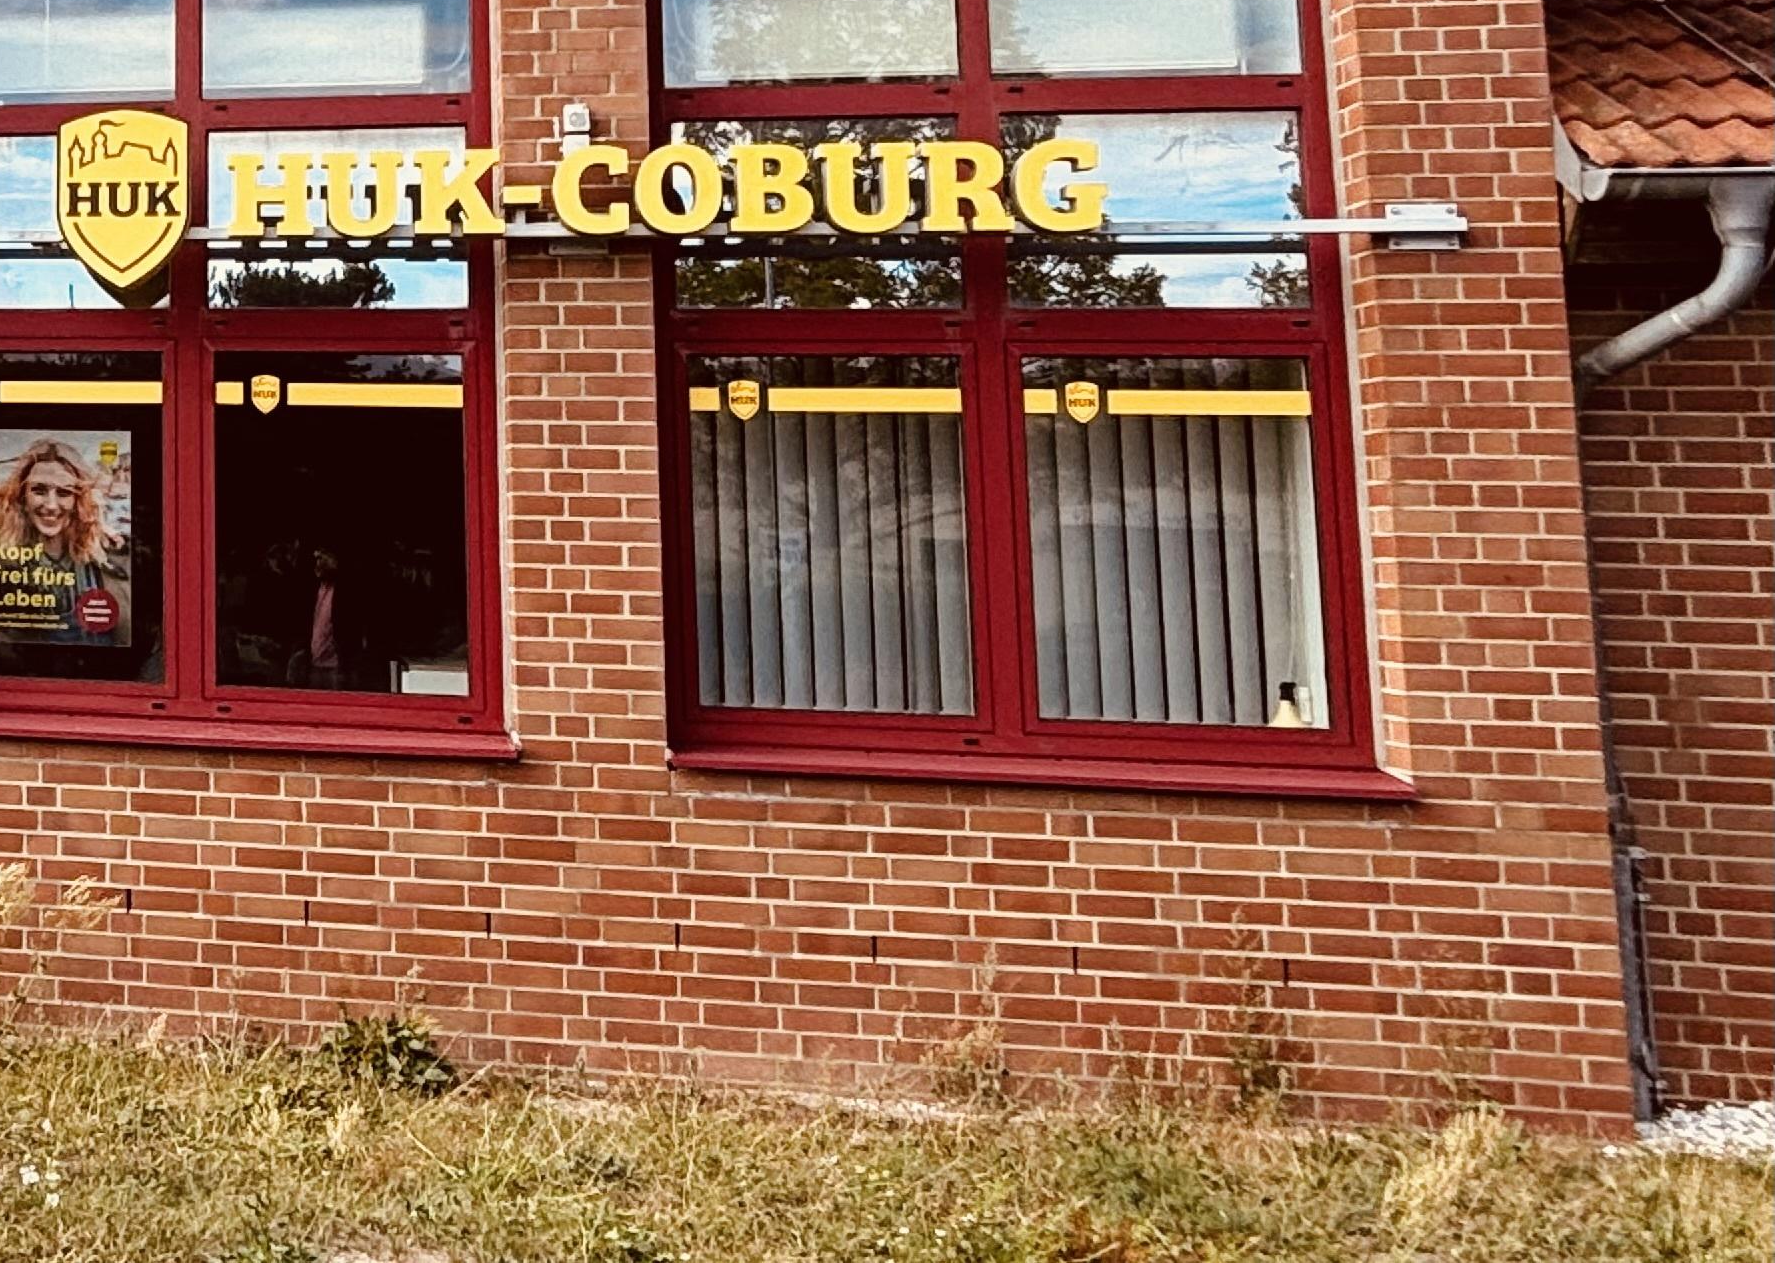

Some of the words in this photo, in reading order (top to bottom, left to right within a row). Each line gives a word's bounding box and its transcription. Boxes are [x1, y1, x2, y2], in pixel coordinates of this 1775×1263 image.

[226, 138, 1108, 237] HUK-COBURG
[66, 181, 181, 218] HUK
[730, 396, 758, 405] HUK
[1068, 398, 1096, 407] HUK
[32, 566, 76, 586] fürs
